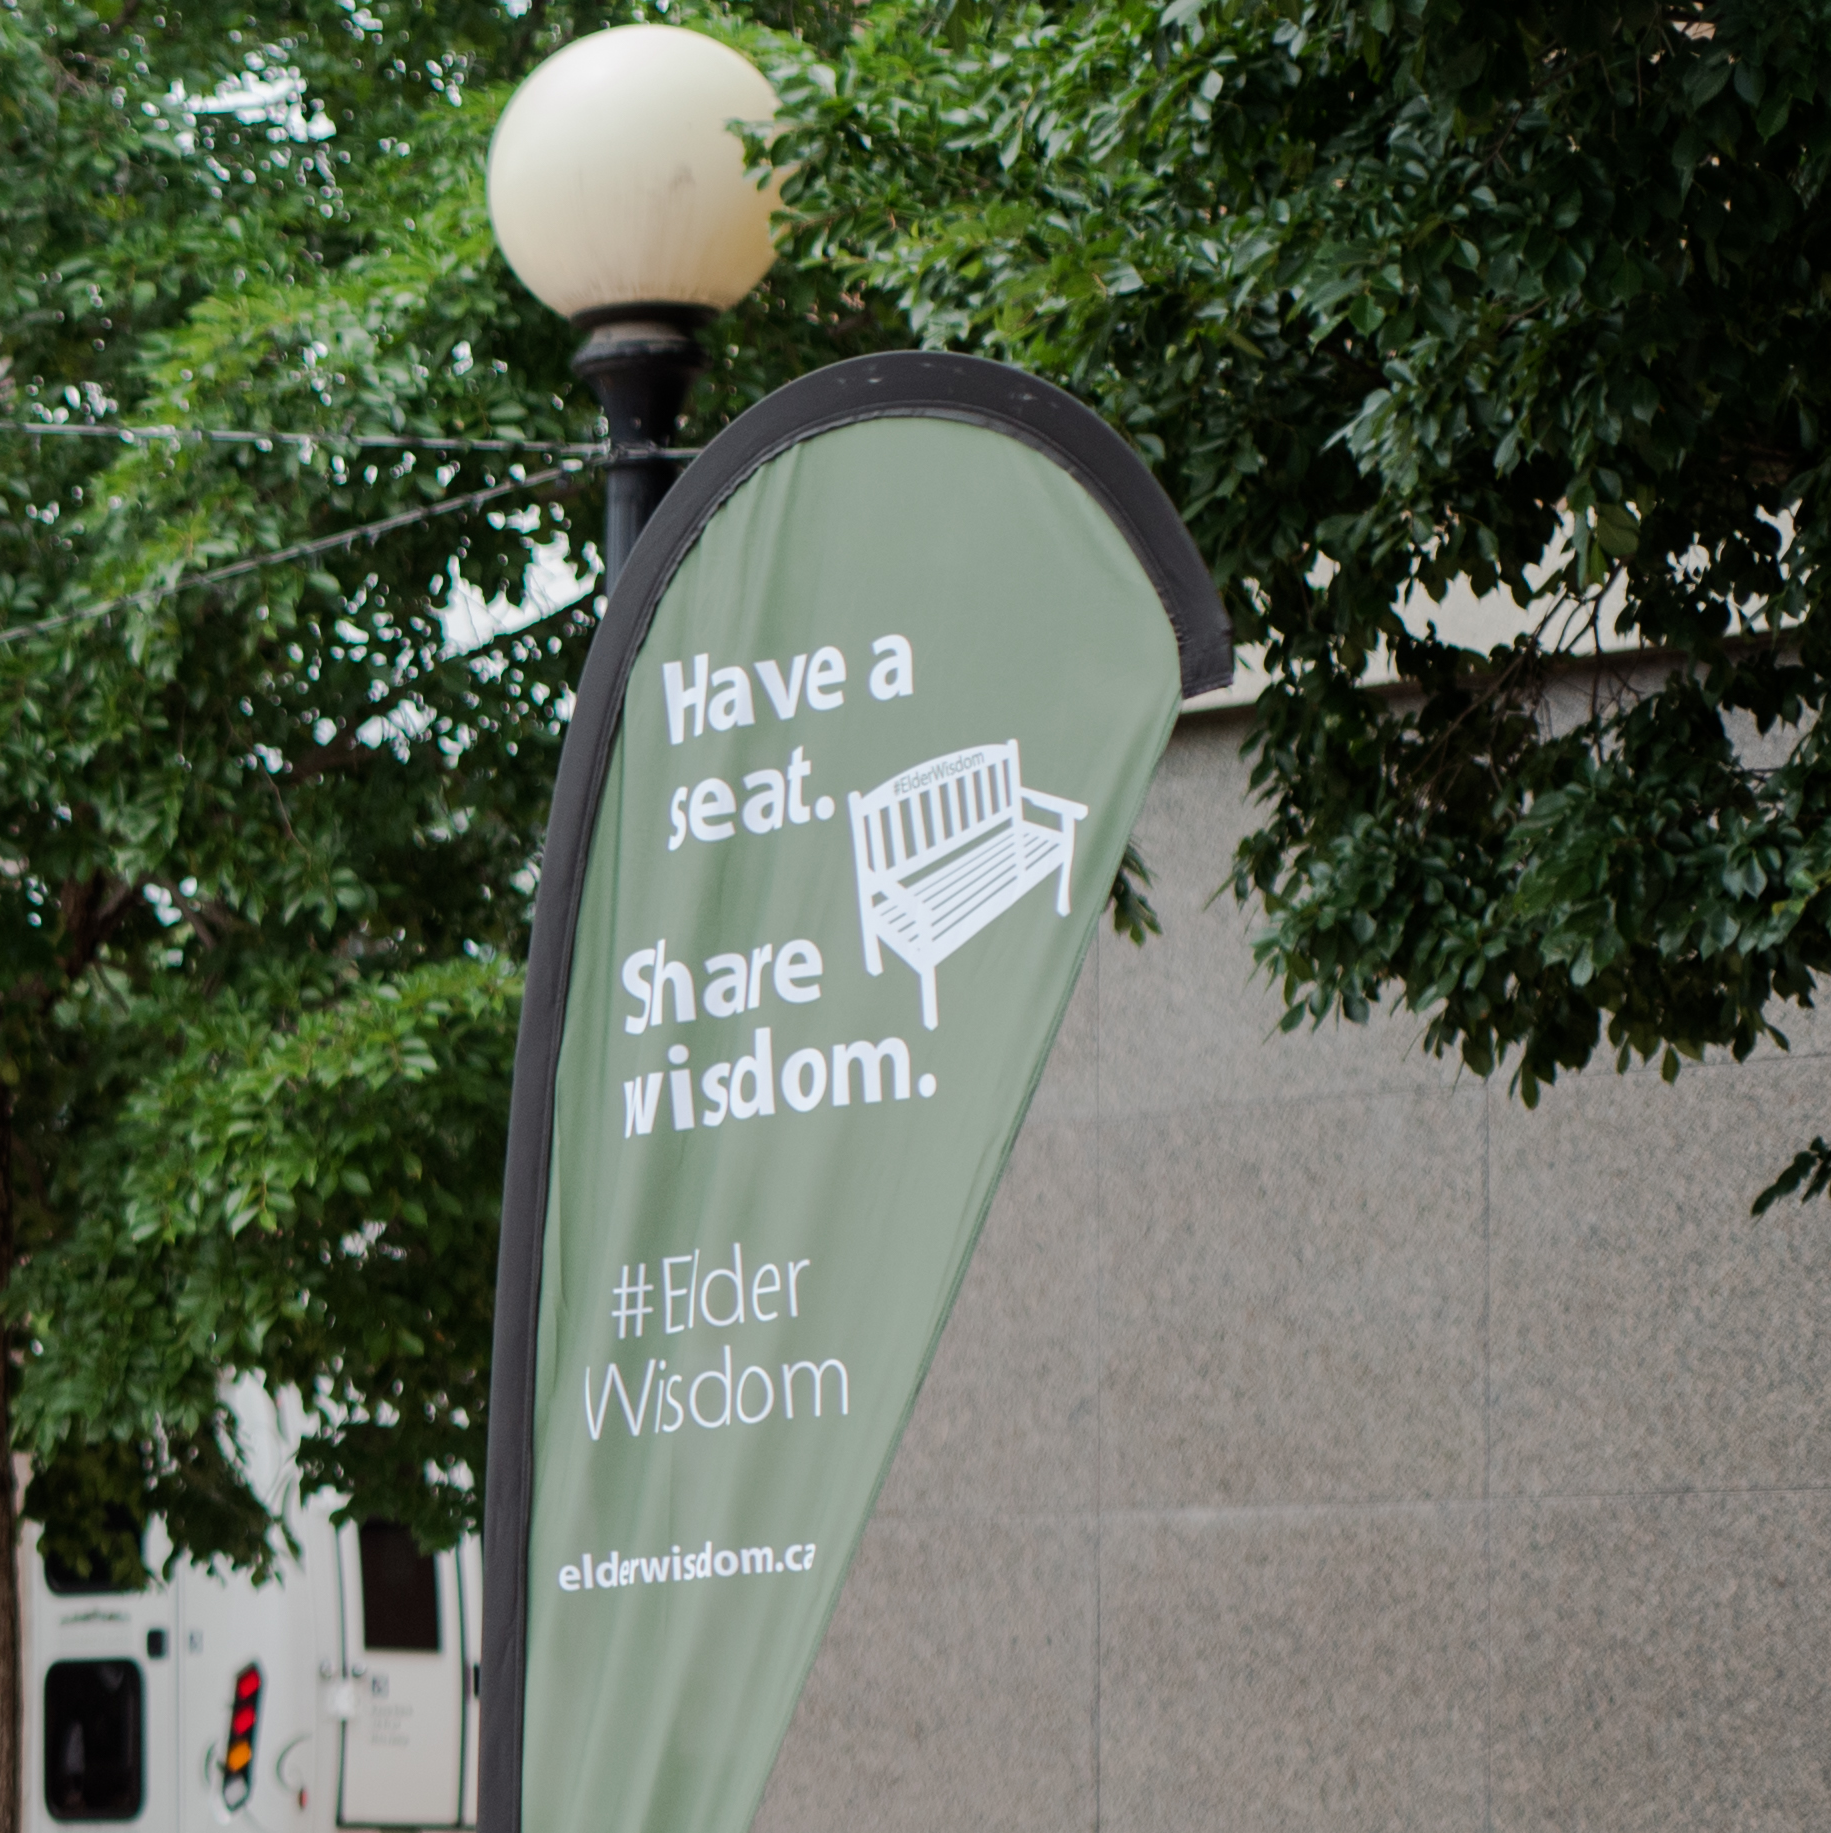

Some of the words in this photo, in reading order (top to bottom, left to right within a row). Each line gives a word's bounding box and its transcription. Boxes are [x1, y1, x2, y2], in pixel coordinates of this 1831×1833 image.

[664, 645, 846, 746] Have
[870, 635, 912, 699] a
[669, 746, 835, 852] seat.
[893, 752, 985, 796] #ElderWisdom
[623, 938, 823, 1036] Share
[624, 1026, 938, 1138] wisdom.
[612, 1243, 809, 1338] #Elder
[586, 1345, 848, 1439] Wisdom
[560, 1541, 815, 1590] elderwisdom.ca
